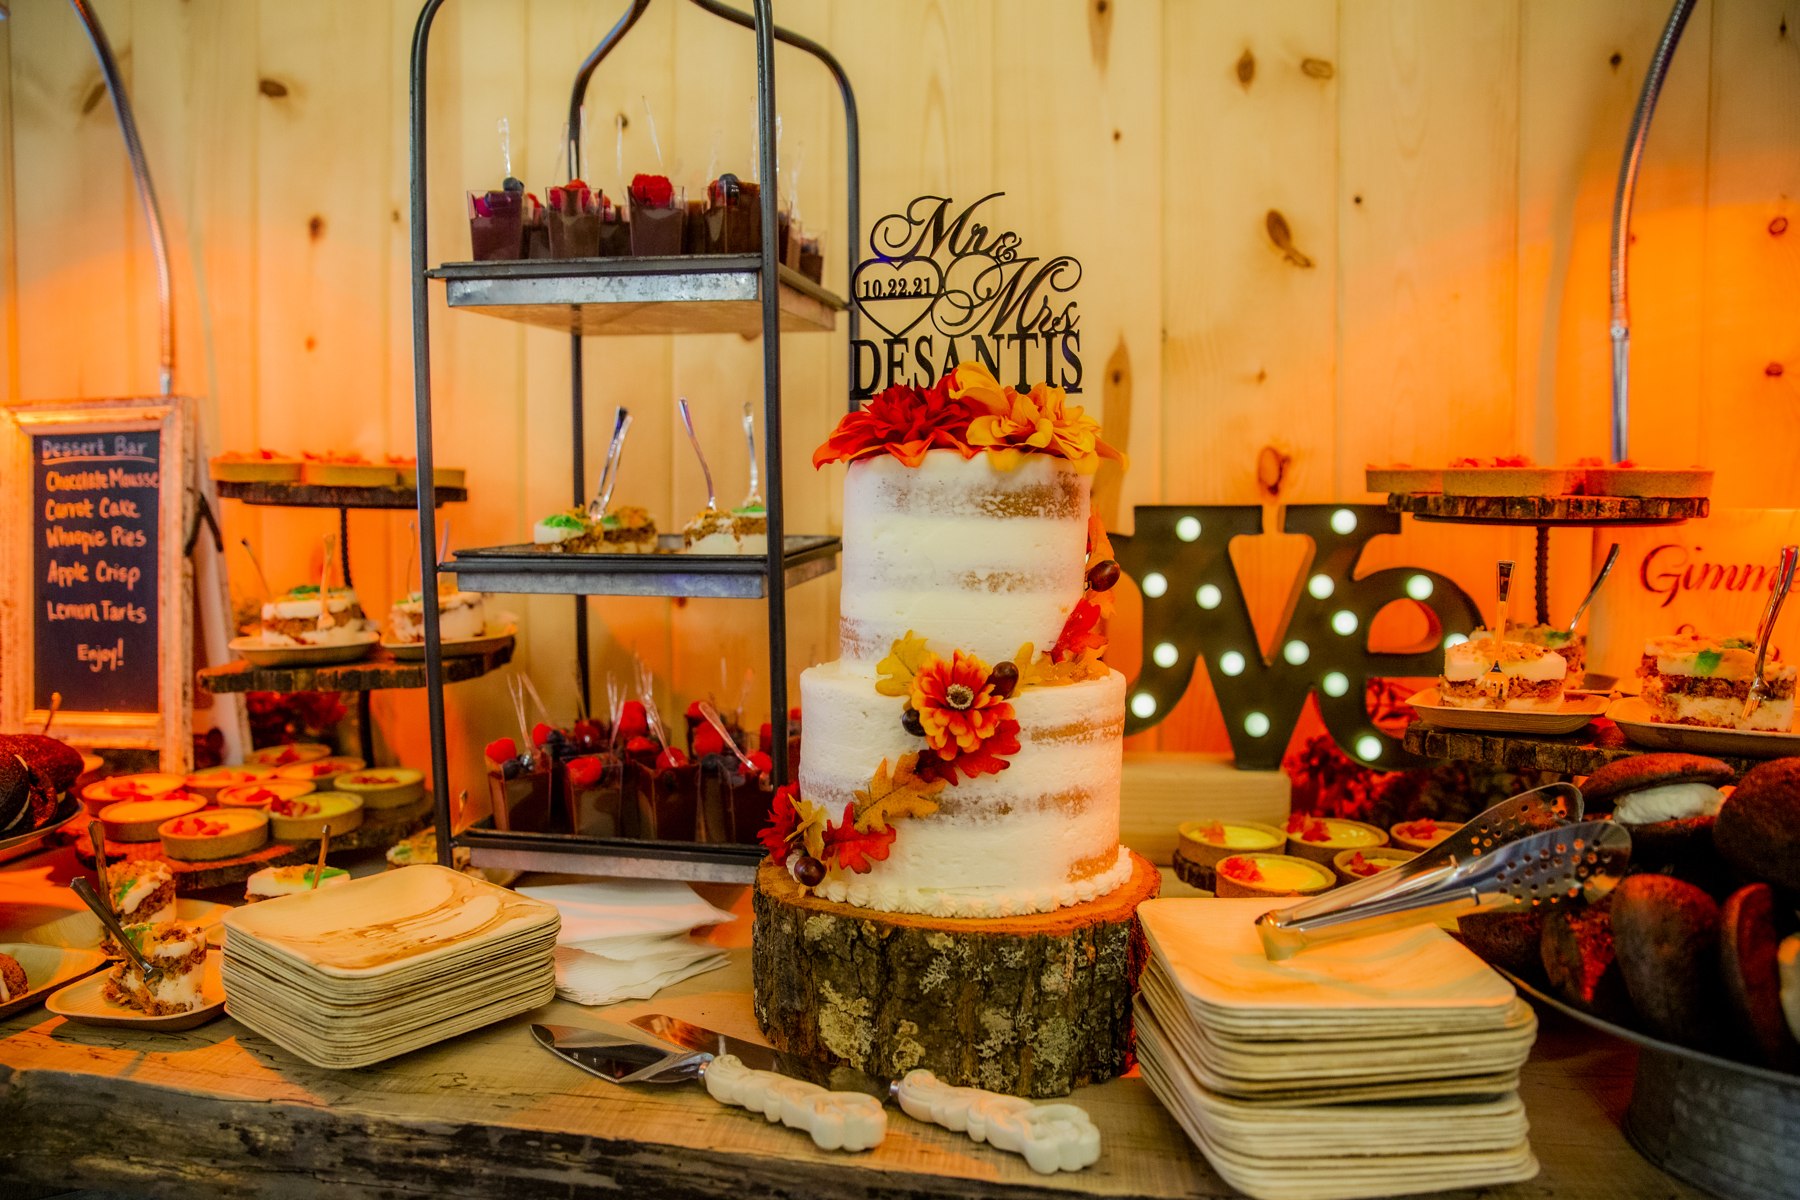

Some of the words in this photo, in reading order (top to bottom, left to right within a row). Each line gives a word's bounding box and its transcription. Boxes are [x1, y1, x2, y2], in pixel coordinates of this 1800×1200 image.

[870, 191, 1006, 260] Mr
[862, 276, 932, 299] 10.22.21
[931, 253, 1083, 339] Mrs
[849, 329, 1083, 401] DESANTIS
[42, 438, 106, 459] Dessert
[114, 435, 148, 456] Bar
[45, 498, 94, 521] Carrot
[99, 496, 141, 519] Cake
[111, 525, 147, 548] Pies
[47, 559, 89, 588] Apple
[95, 559, 141, 591] Crisp
[46, 600, 99, 622] Lemon
[100, 600, 147, 624] Tarts
[77, 637, 124, 673] Enjoy!
